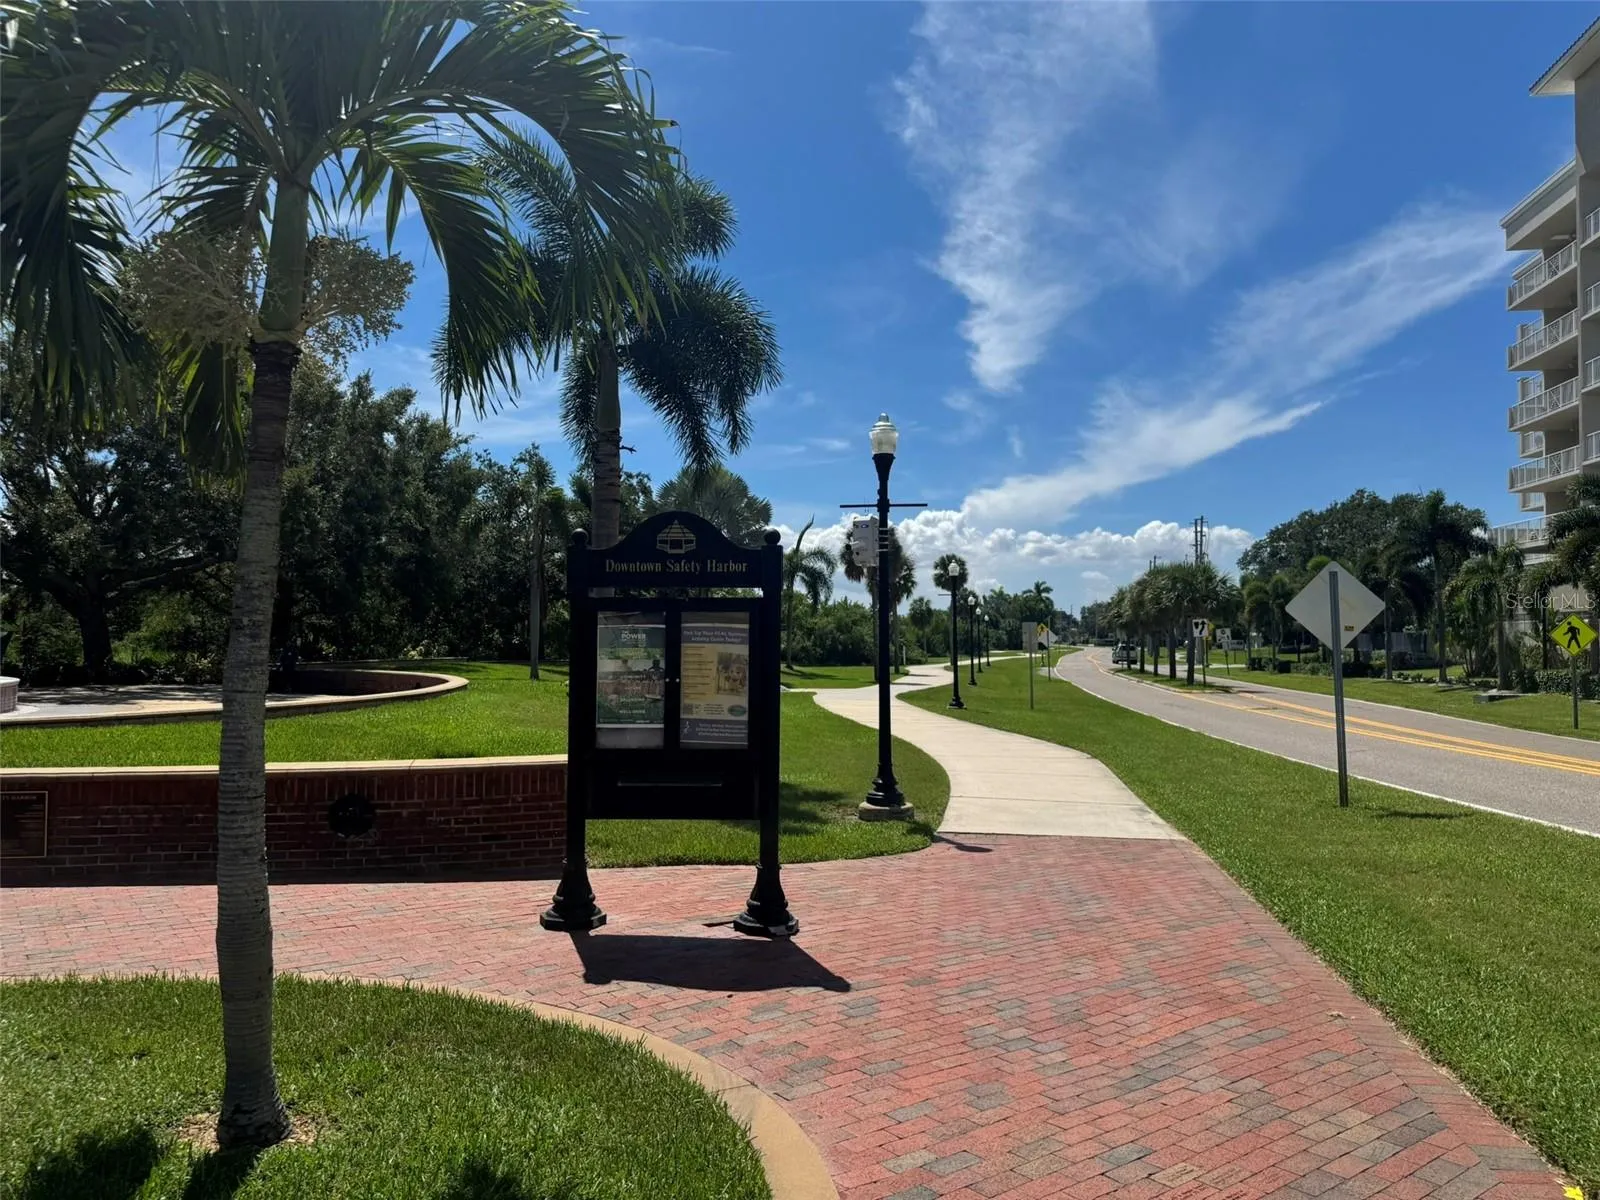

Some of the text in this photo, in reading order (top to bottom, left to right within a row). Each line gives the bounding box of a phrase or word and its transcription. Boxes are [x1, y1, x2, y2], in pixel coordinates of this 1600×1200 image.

[605, 559, 748, 574] Downtown Safety Harbor
